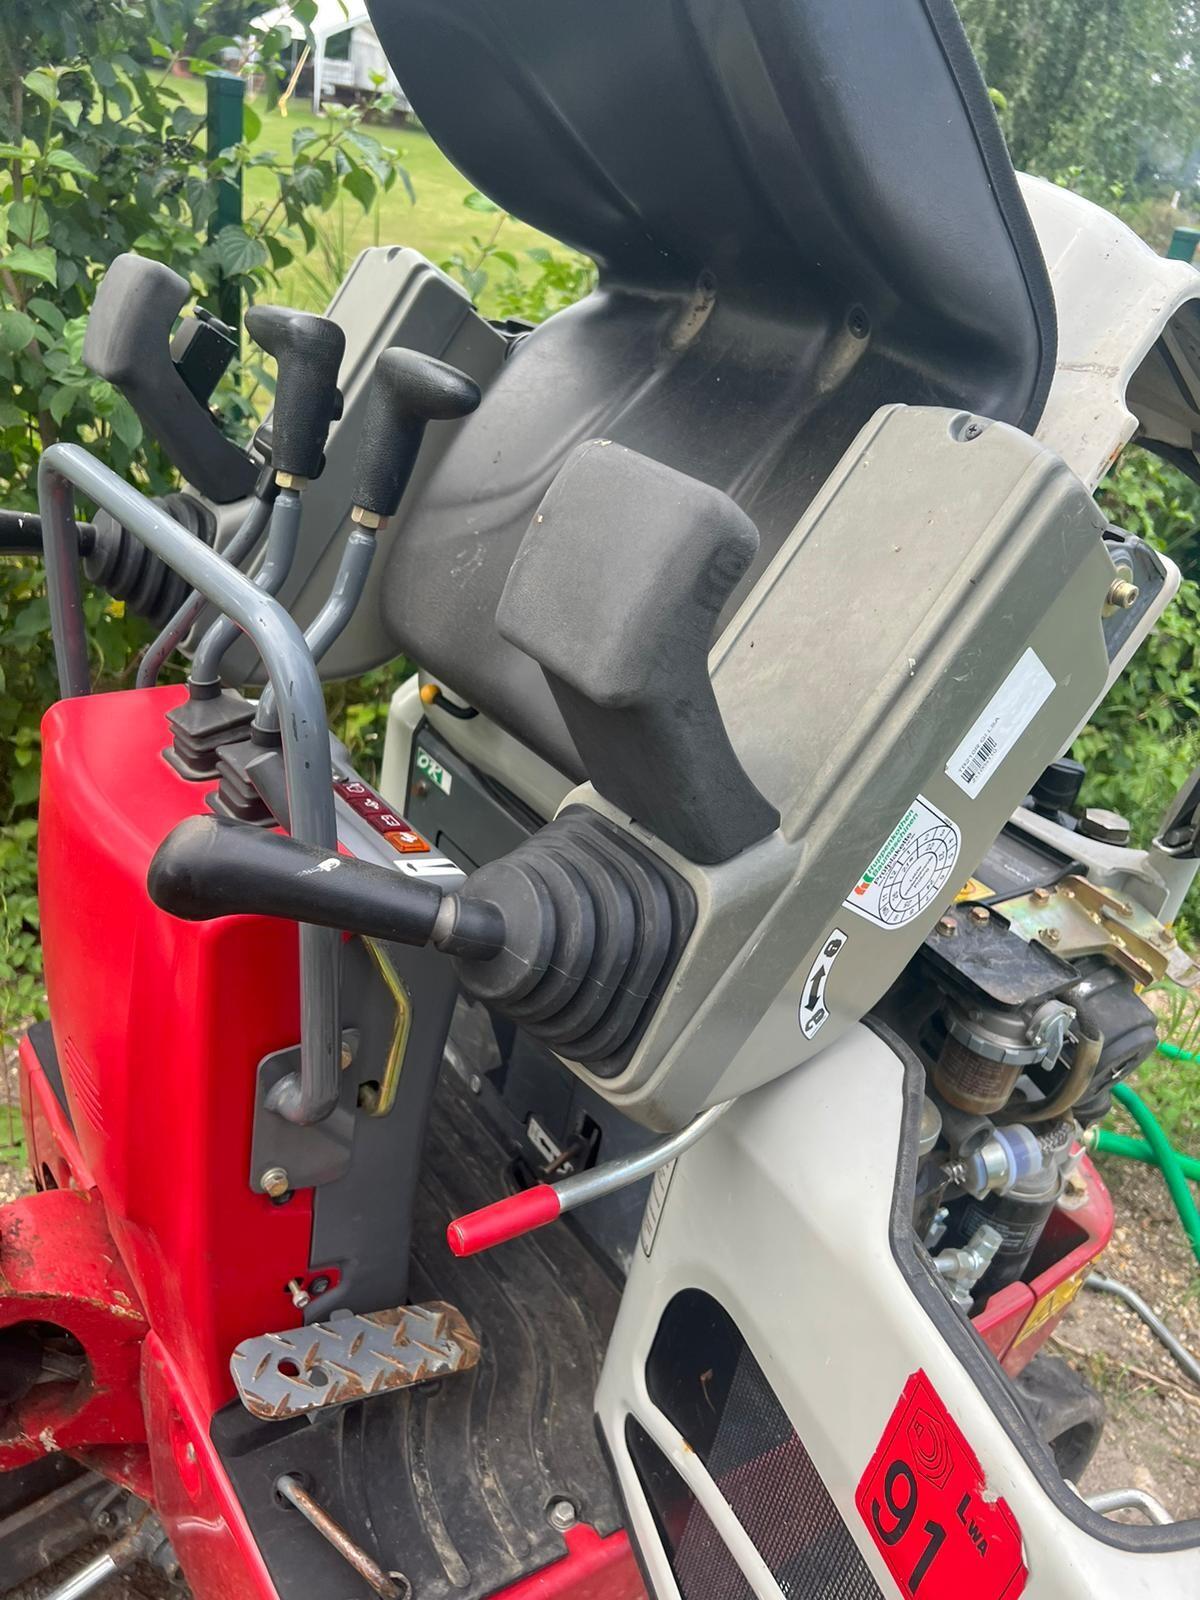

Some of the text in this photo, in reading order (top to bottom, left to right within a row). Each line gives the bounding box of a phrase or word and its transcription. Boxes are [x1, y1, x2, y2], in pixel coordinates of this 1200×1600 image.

[417, 754, 442, 781] OK
[867, 809, 914, 875] Huppenkothen
[872, 813, 919, 878] Baumaschinen
[871, 1459, 947, 1596] 91
